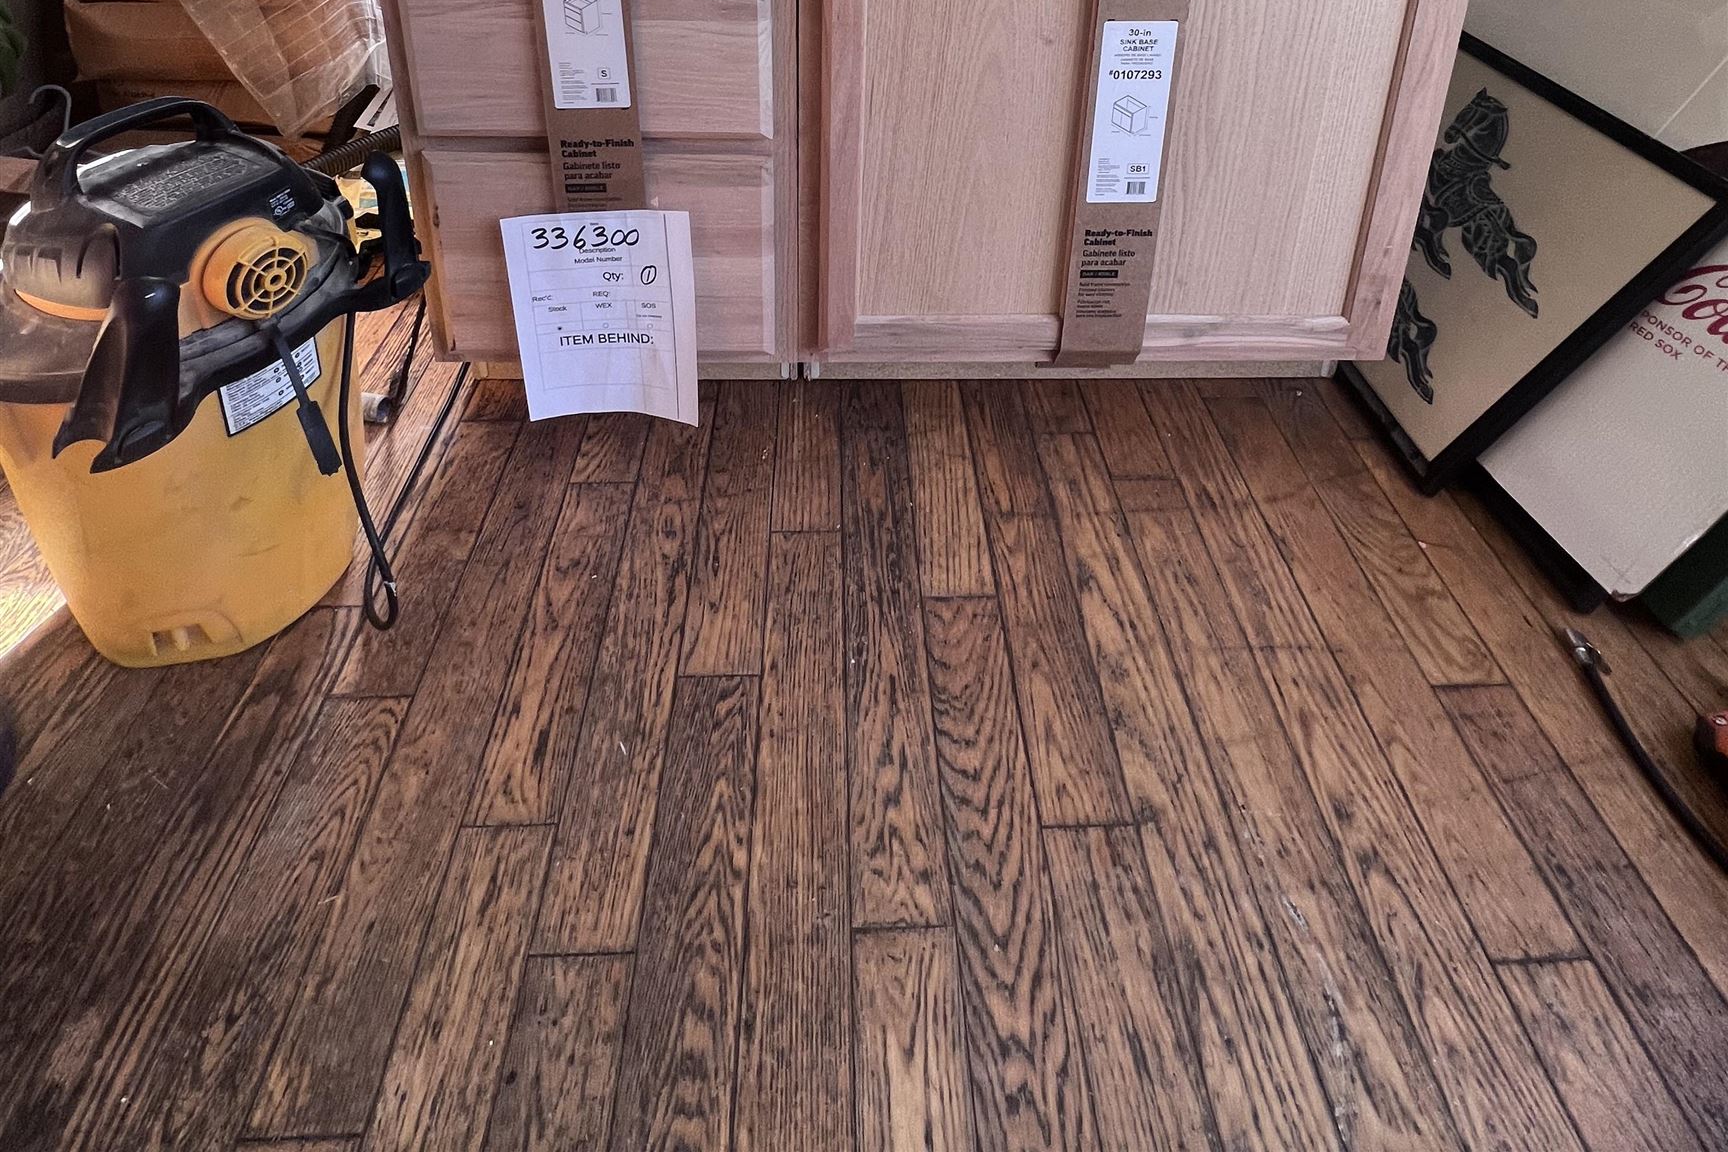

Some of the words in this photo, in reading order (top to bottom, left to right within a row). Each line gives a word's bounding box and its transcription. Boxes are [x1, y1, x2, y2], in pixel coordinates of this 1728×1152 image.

[1128, 28, 1152, 37] 30-in
[601, 69, 608, 78] S
[1109, 70, 1162, 80] #0107293
[560, 139, 635, 149] Ready-to-Finish
[563, 161, 600, 170] Gabinete
[601, 161, 621, 169] listo
[1130, 165, 1146, 173] SB1
[564, 173, 583, 181] para
[584, 171, 612, 179] acabar
[531, 225, 640, 250] 336300
[1084, 229, 1153, 238] Ready-to-Finish
[1083, 238, 1116, 246] Cabinet
[1082, 249, 1117, 257] Gabinete
[1118, 249, 1136, 257] listo
[1081, 260, 1099, 268] para
[1100, 258, 1126, 266] acabar
[602, 272, 624, 282] Qty:
[560, 334, 594, 346] ITEM
[598, 333, 654, 344] BEHIND:
[1629, 321, 1654, 341] RED
[1654, 338, 1683, 360] SOX
[1693, 344, 1715, 359] OF
